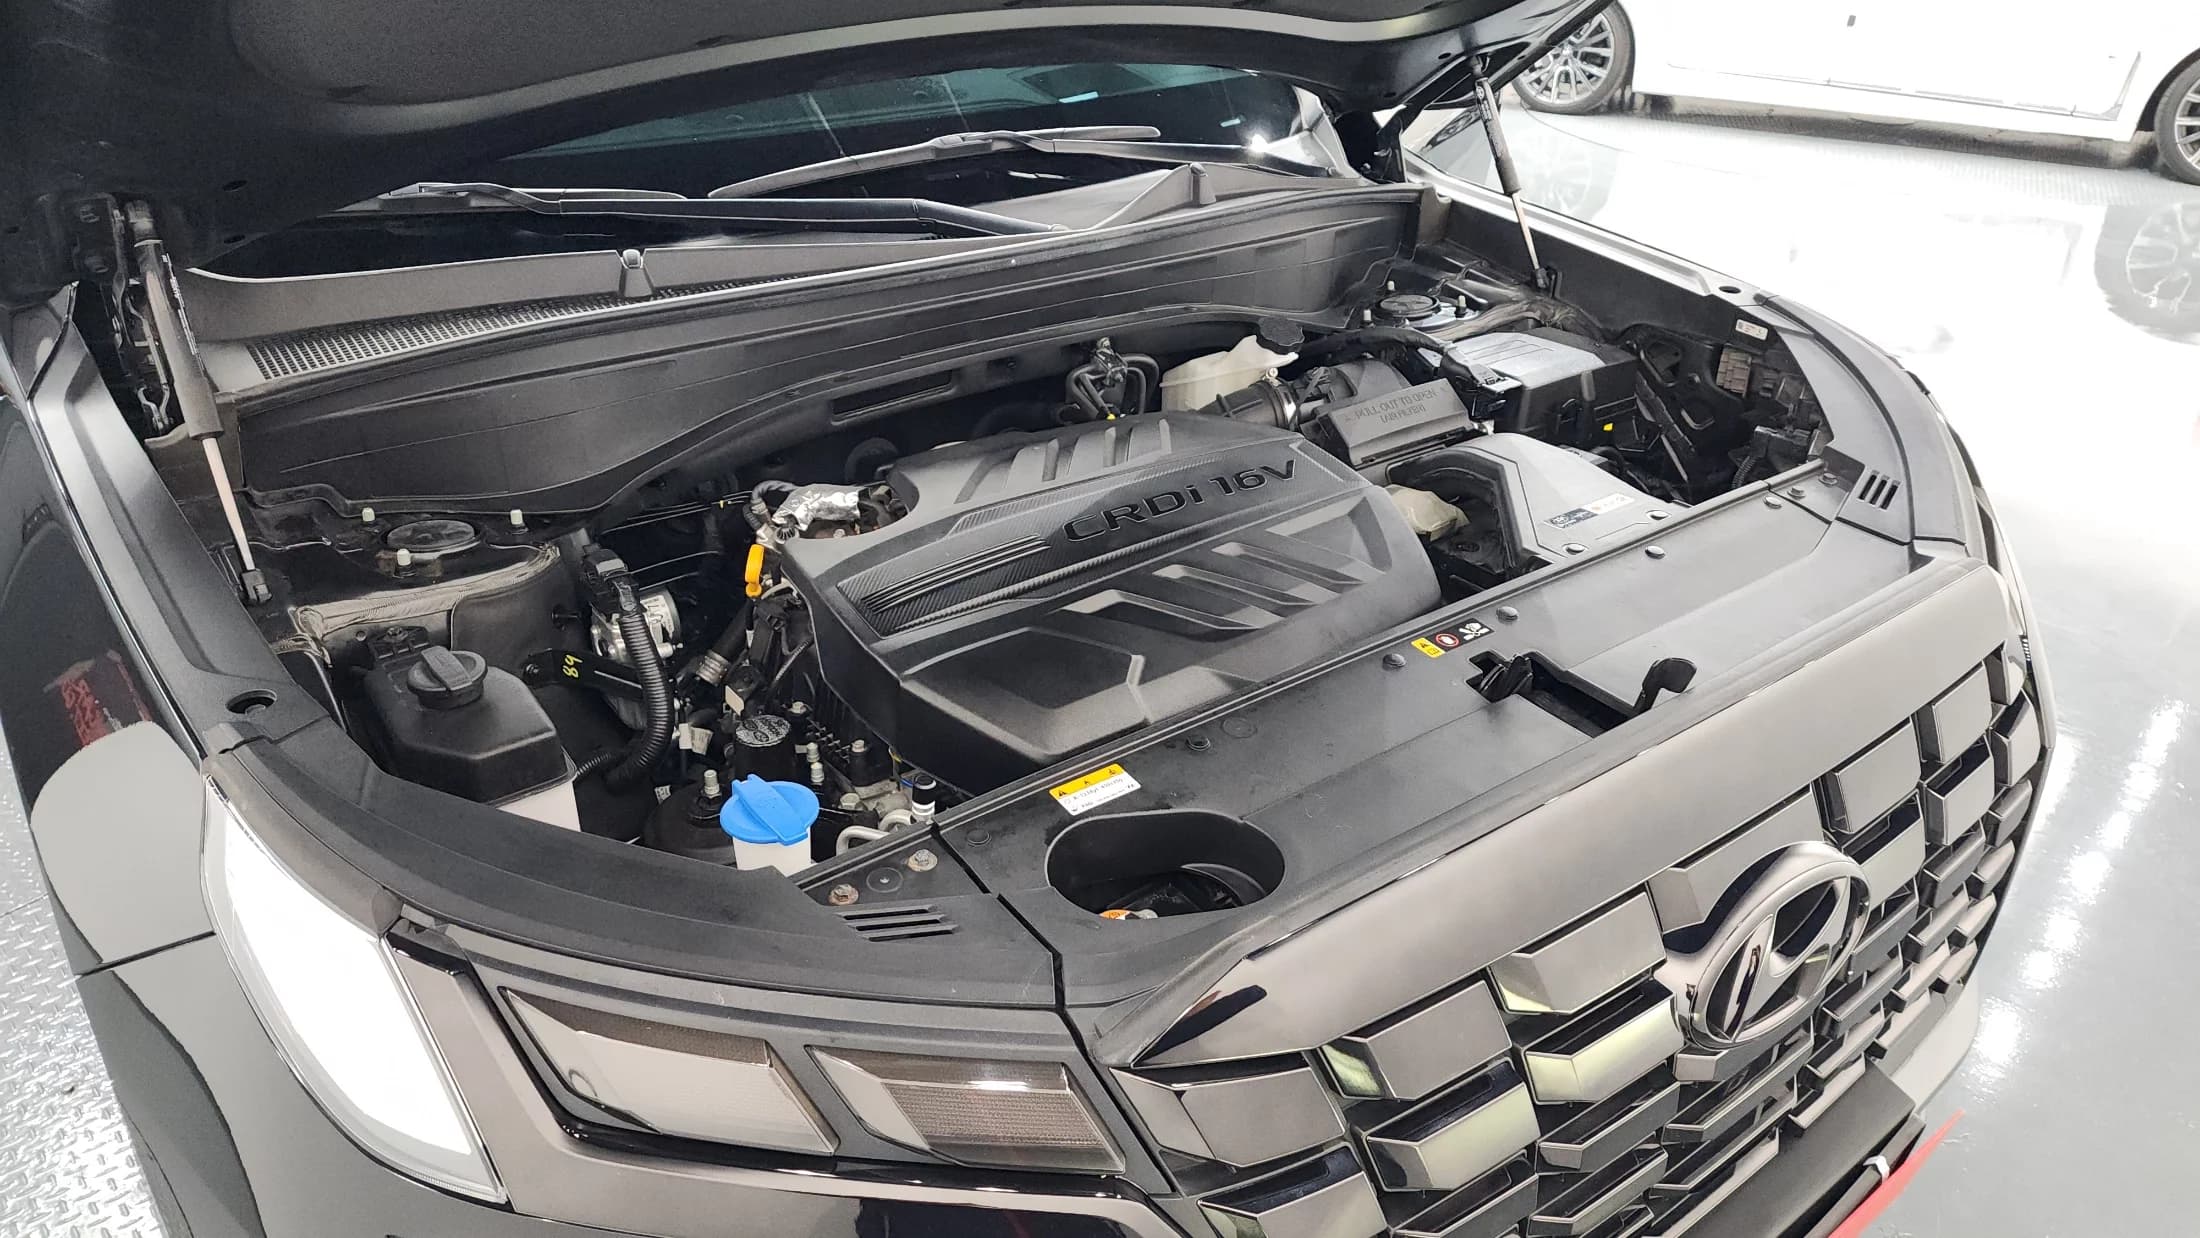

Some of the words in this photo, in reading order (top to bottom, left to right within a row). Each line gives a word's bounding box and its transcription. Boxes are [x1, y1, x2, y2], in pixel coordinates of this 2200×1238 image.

[1379, 399, 1399, 411] OUT
[1398, 394, 1413, 407] TO
[1412, 389, 1437, 402] OPEN
[1063, 485, 1205, 542] CRDi
[1208, 459, 1296, 496] 16V
[562, 654, 583, 678] 89
